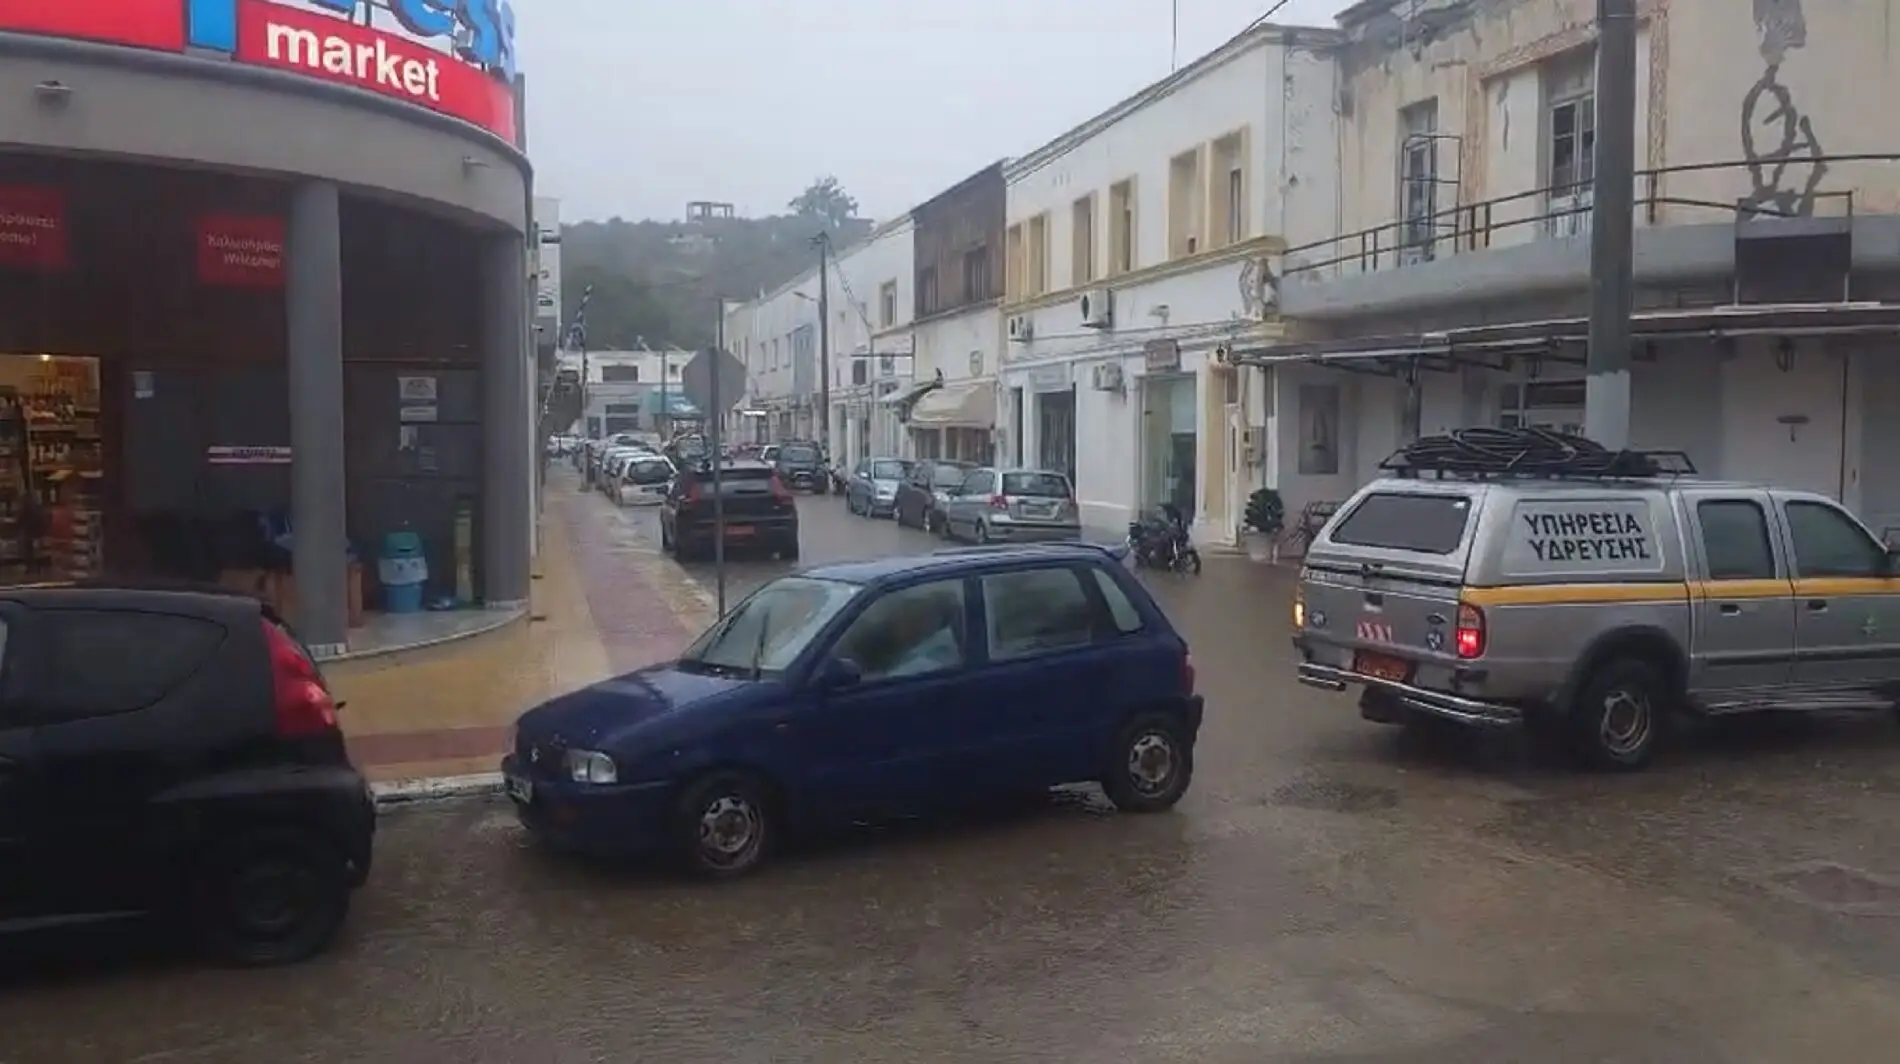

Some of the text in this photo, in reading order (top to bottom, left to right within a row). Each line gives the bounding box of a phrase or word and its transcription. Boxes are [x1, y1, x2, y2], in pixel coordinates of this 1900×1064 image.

[265, 22, 439, 100] market
[1523, 513, 1642, 536] ΥΠΗΡΕΣΙΑ
[1528, 537, 1650, 560] ΥΔΡΕΥΣΗΣ
